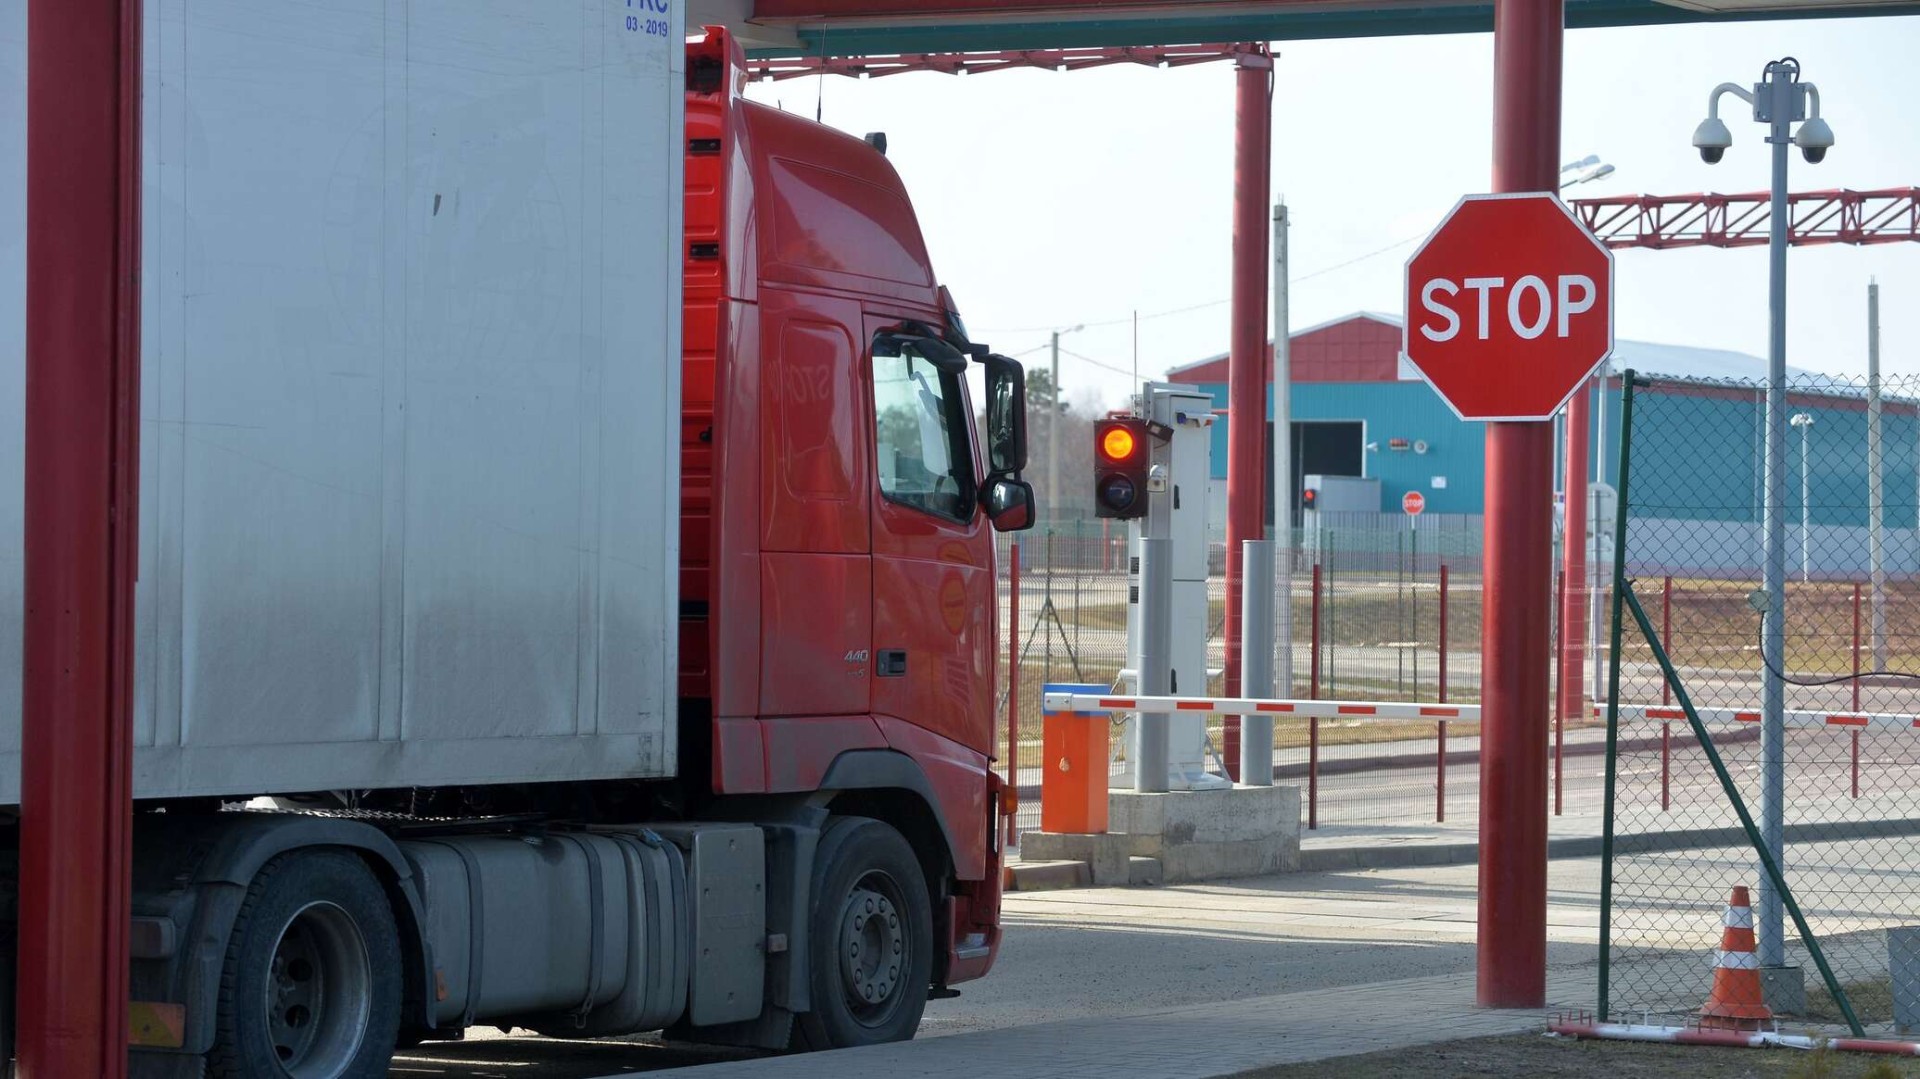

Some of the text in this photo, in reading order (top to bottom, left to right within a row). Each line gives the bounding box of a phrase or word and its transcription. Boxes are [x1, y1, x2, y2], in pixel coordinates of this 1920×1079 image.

[1420, 275, 1596, 342] STOP
[1404, 499, 1422, 508] STOP
[844, 650, 868, 662] 440
